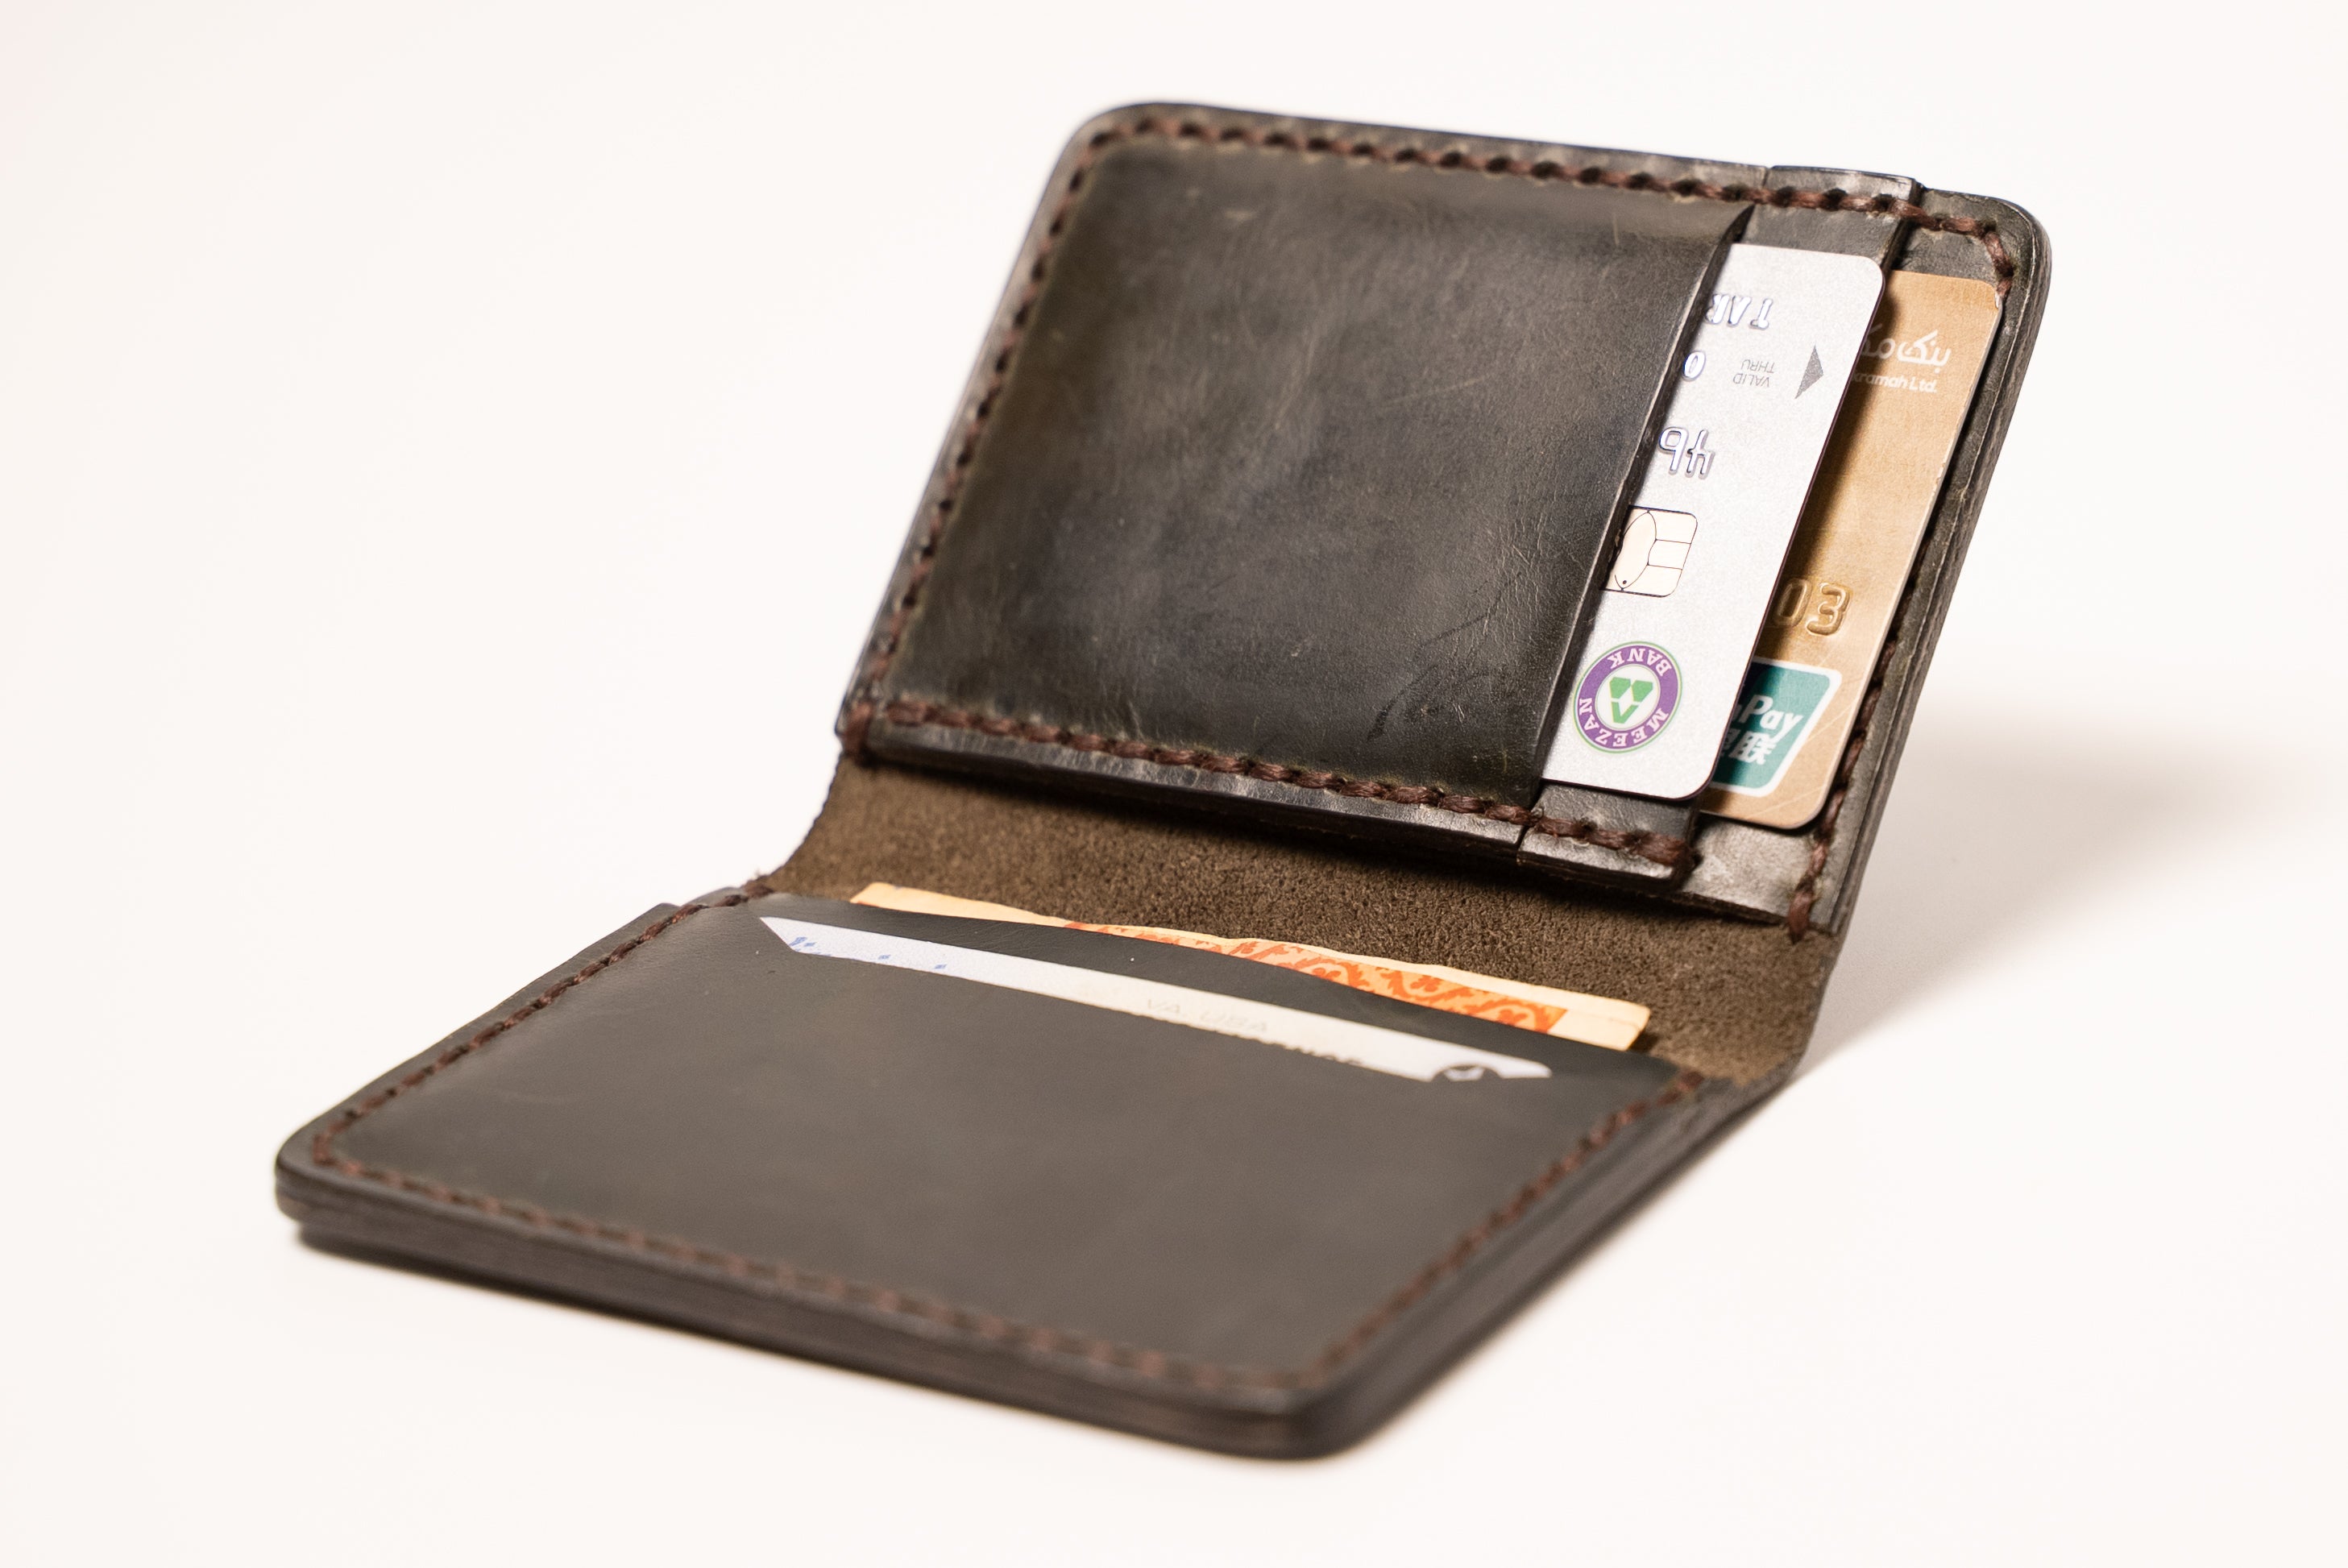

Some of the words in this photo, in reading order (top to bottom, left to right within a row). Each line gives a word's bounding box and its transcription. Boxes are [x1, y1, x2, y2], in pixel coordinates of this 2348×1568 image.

[1732, 373, 1770, 388] VALID
[1740, 359, 1775, 374] THRU
[1774, 579, 1851, 636] 03
[1607, 648, 1673, 677] BANK
[1578, 697, 1670, 748] MEEZAN
